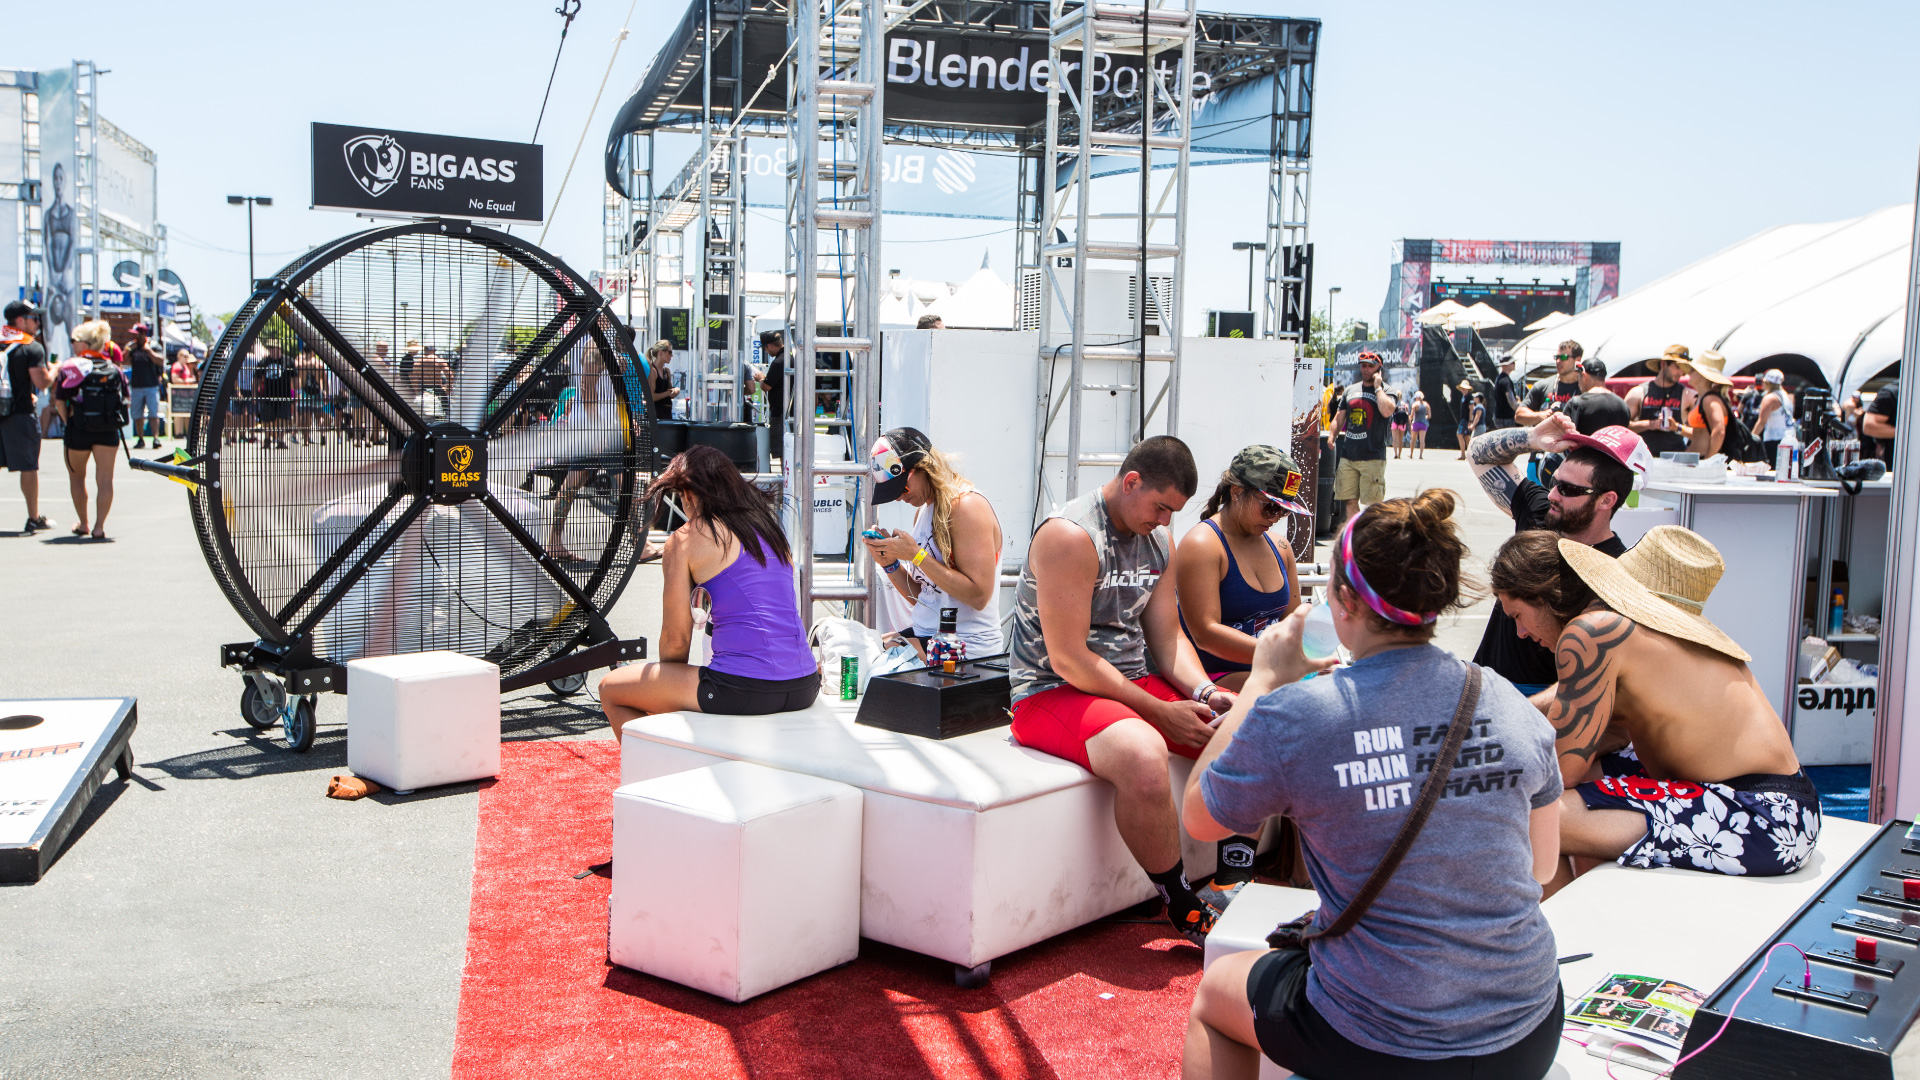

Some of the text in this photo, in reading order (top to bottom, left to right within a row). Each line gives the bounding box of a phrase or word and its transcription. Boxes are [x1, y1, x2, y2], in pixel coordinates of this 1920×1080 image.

[410, 176, 445, 191] FANS
[468, 198, 516, 213] No Equal
[813, 499, 842, 507] UBLIC
[1798, 687, 1876, 717] uture
[1353, 726, 1404, 755] RUN
[1333, 754, 1409, 787] TRAIN
[1364, 782, 1412, 811] LIFT
